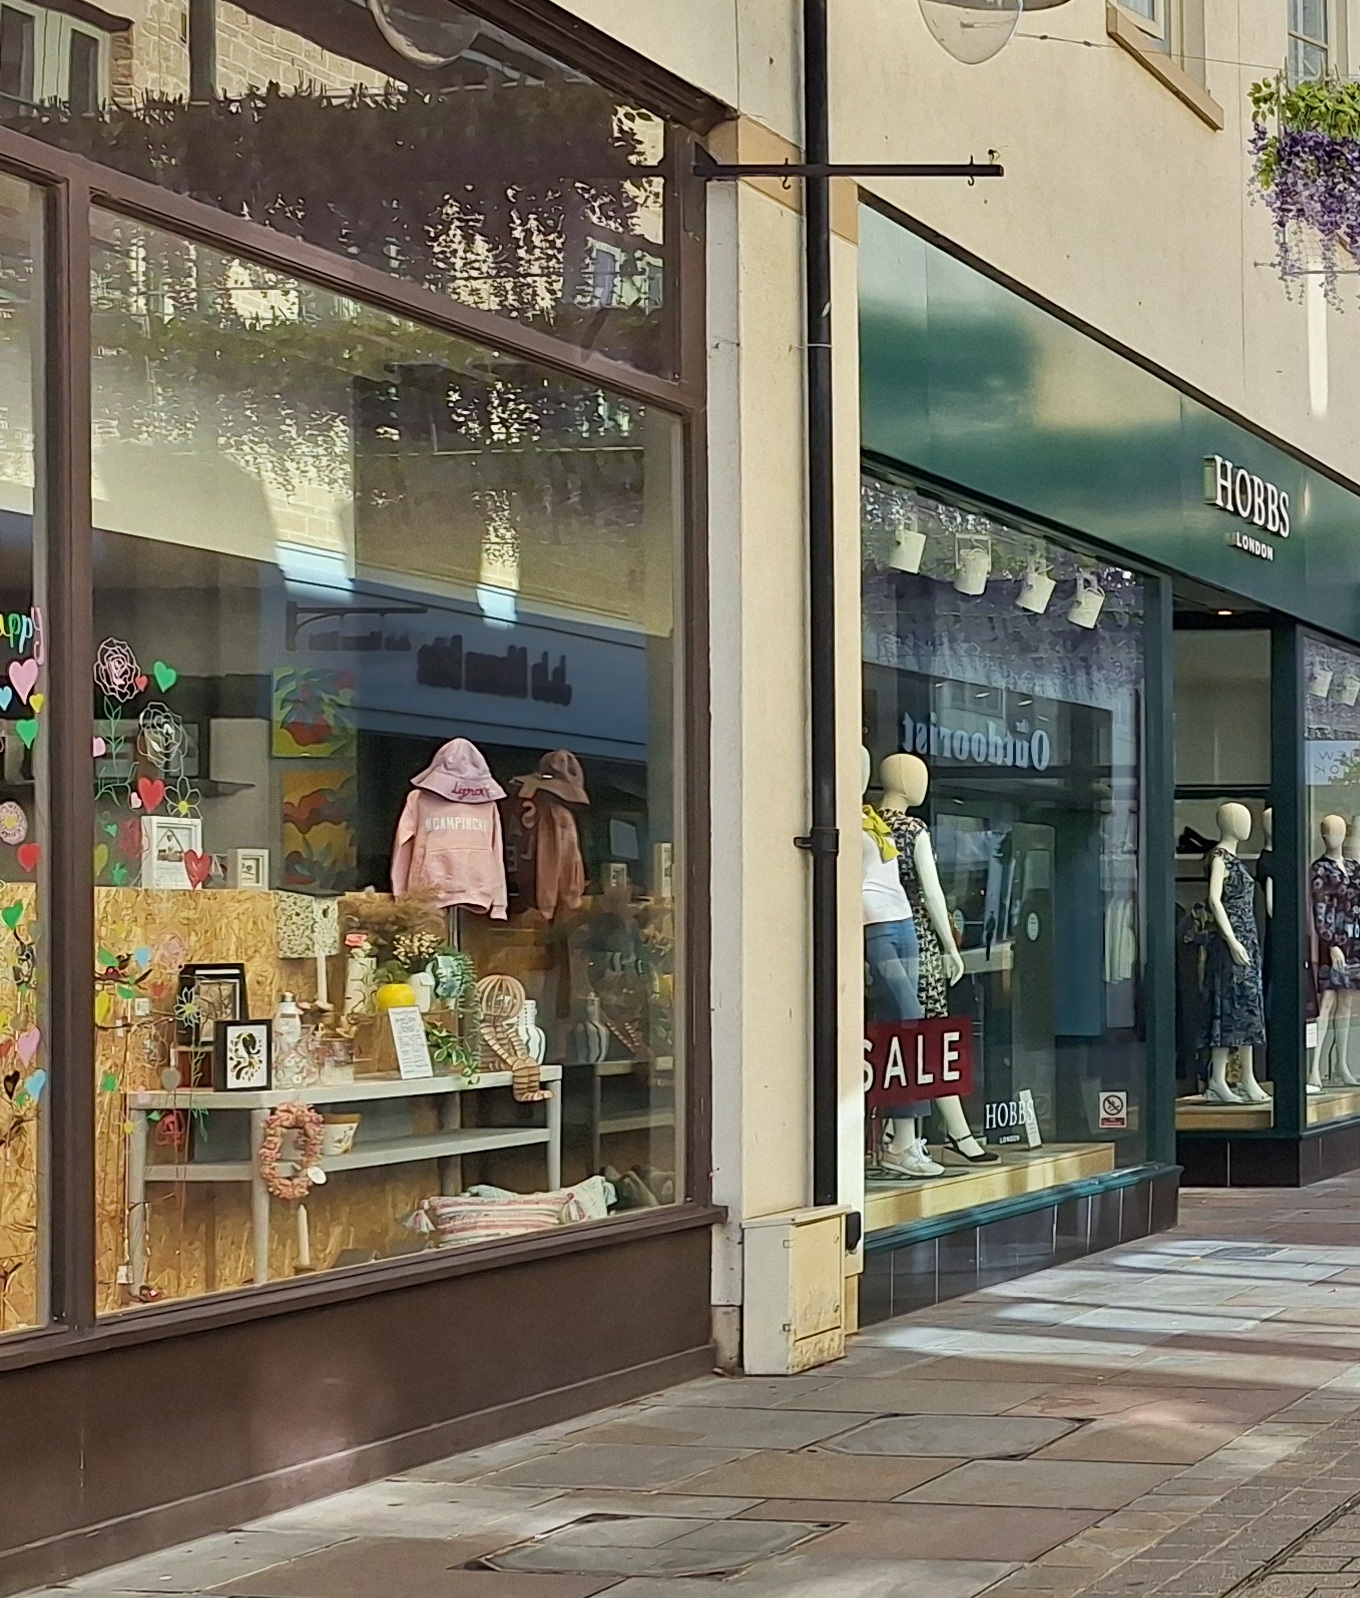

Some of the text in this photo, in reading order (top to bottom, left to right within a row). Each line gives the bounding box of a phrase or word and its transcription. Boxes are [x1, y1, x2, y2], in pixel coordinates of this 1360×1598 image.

[1214, 454, 1290, 538] HOBBS
[1236, 531, 1274, 561] LONDON
[985, 1100, 1035, 1130] HOBBS
